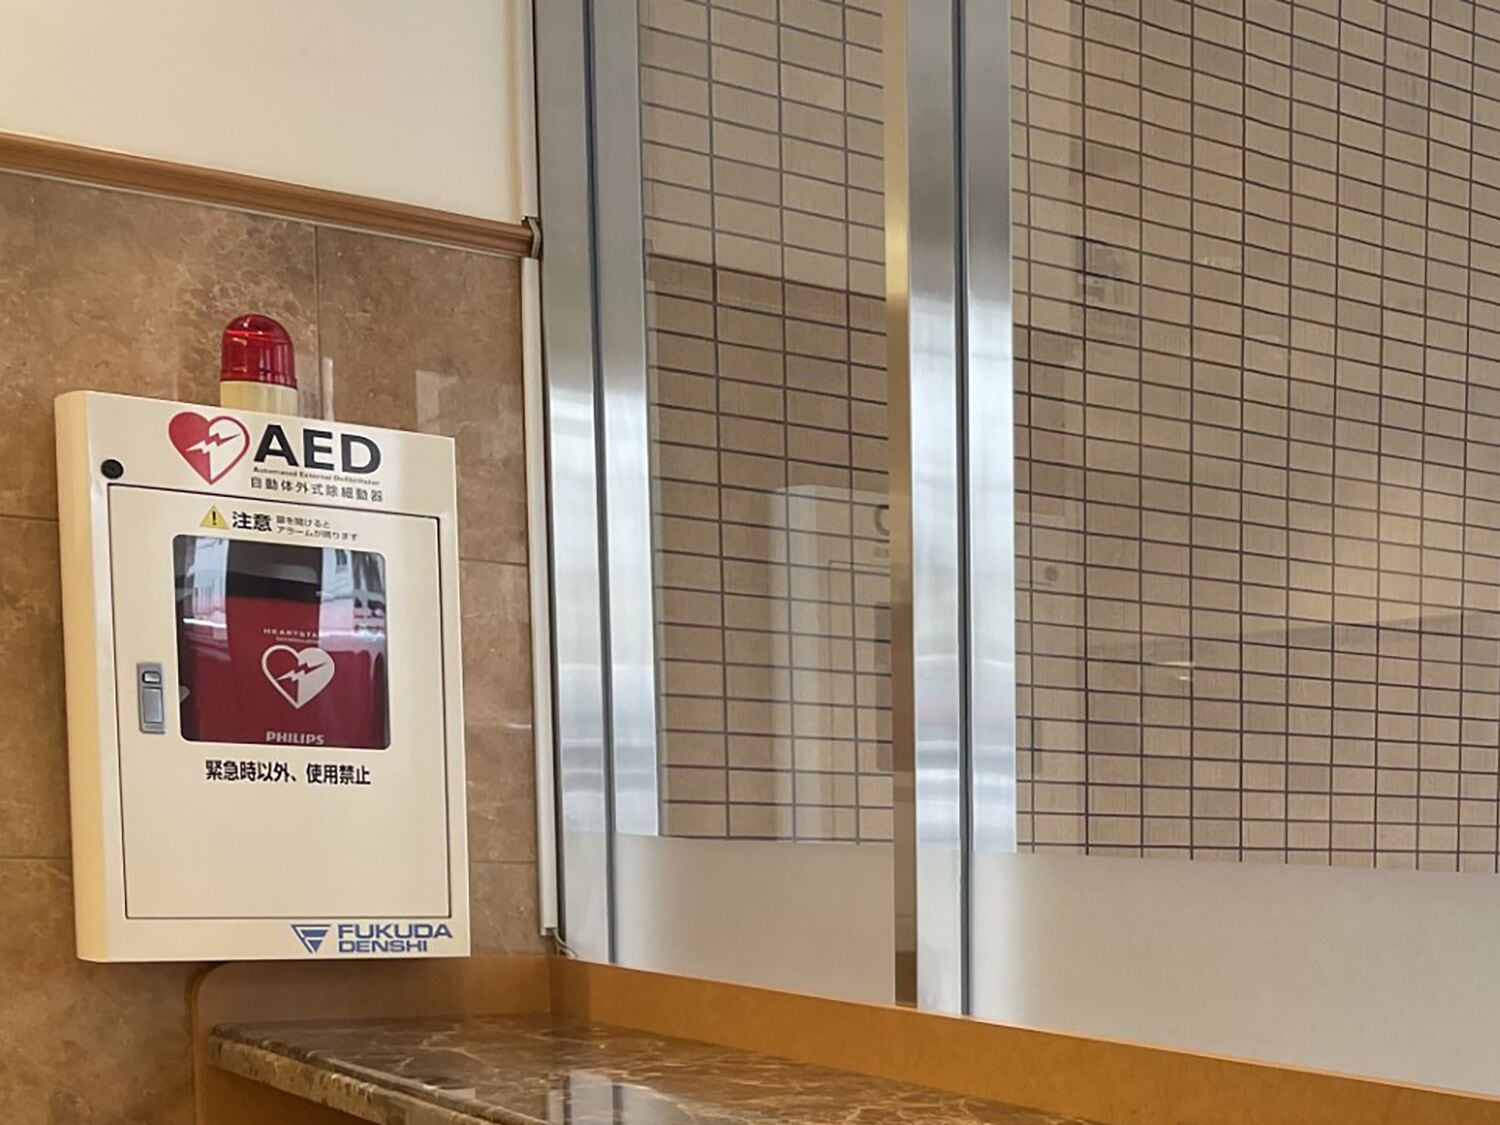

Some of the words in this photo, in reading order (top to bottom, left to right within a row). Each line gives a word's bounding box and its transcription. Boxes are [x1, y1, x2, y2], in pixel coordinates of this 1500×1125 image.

[253, 424, 382, 475] AED
[250, 477, 383, 502] 自動体外式除細動器
[232, 510, 273, 531] 注意
[276, 525, 358, 541] アラームが鳴ります
[263, 628, 319, 638] HEARTSTA
[266, 731, 324, 745] PHILIPS
[206, 760, 371, 785] 緊急時以外、使用禁止
[338, 923, 453, 939] FUKUDA
[338, 940, 428, 953] DENSHI
